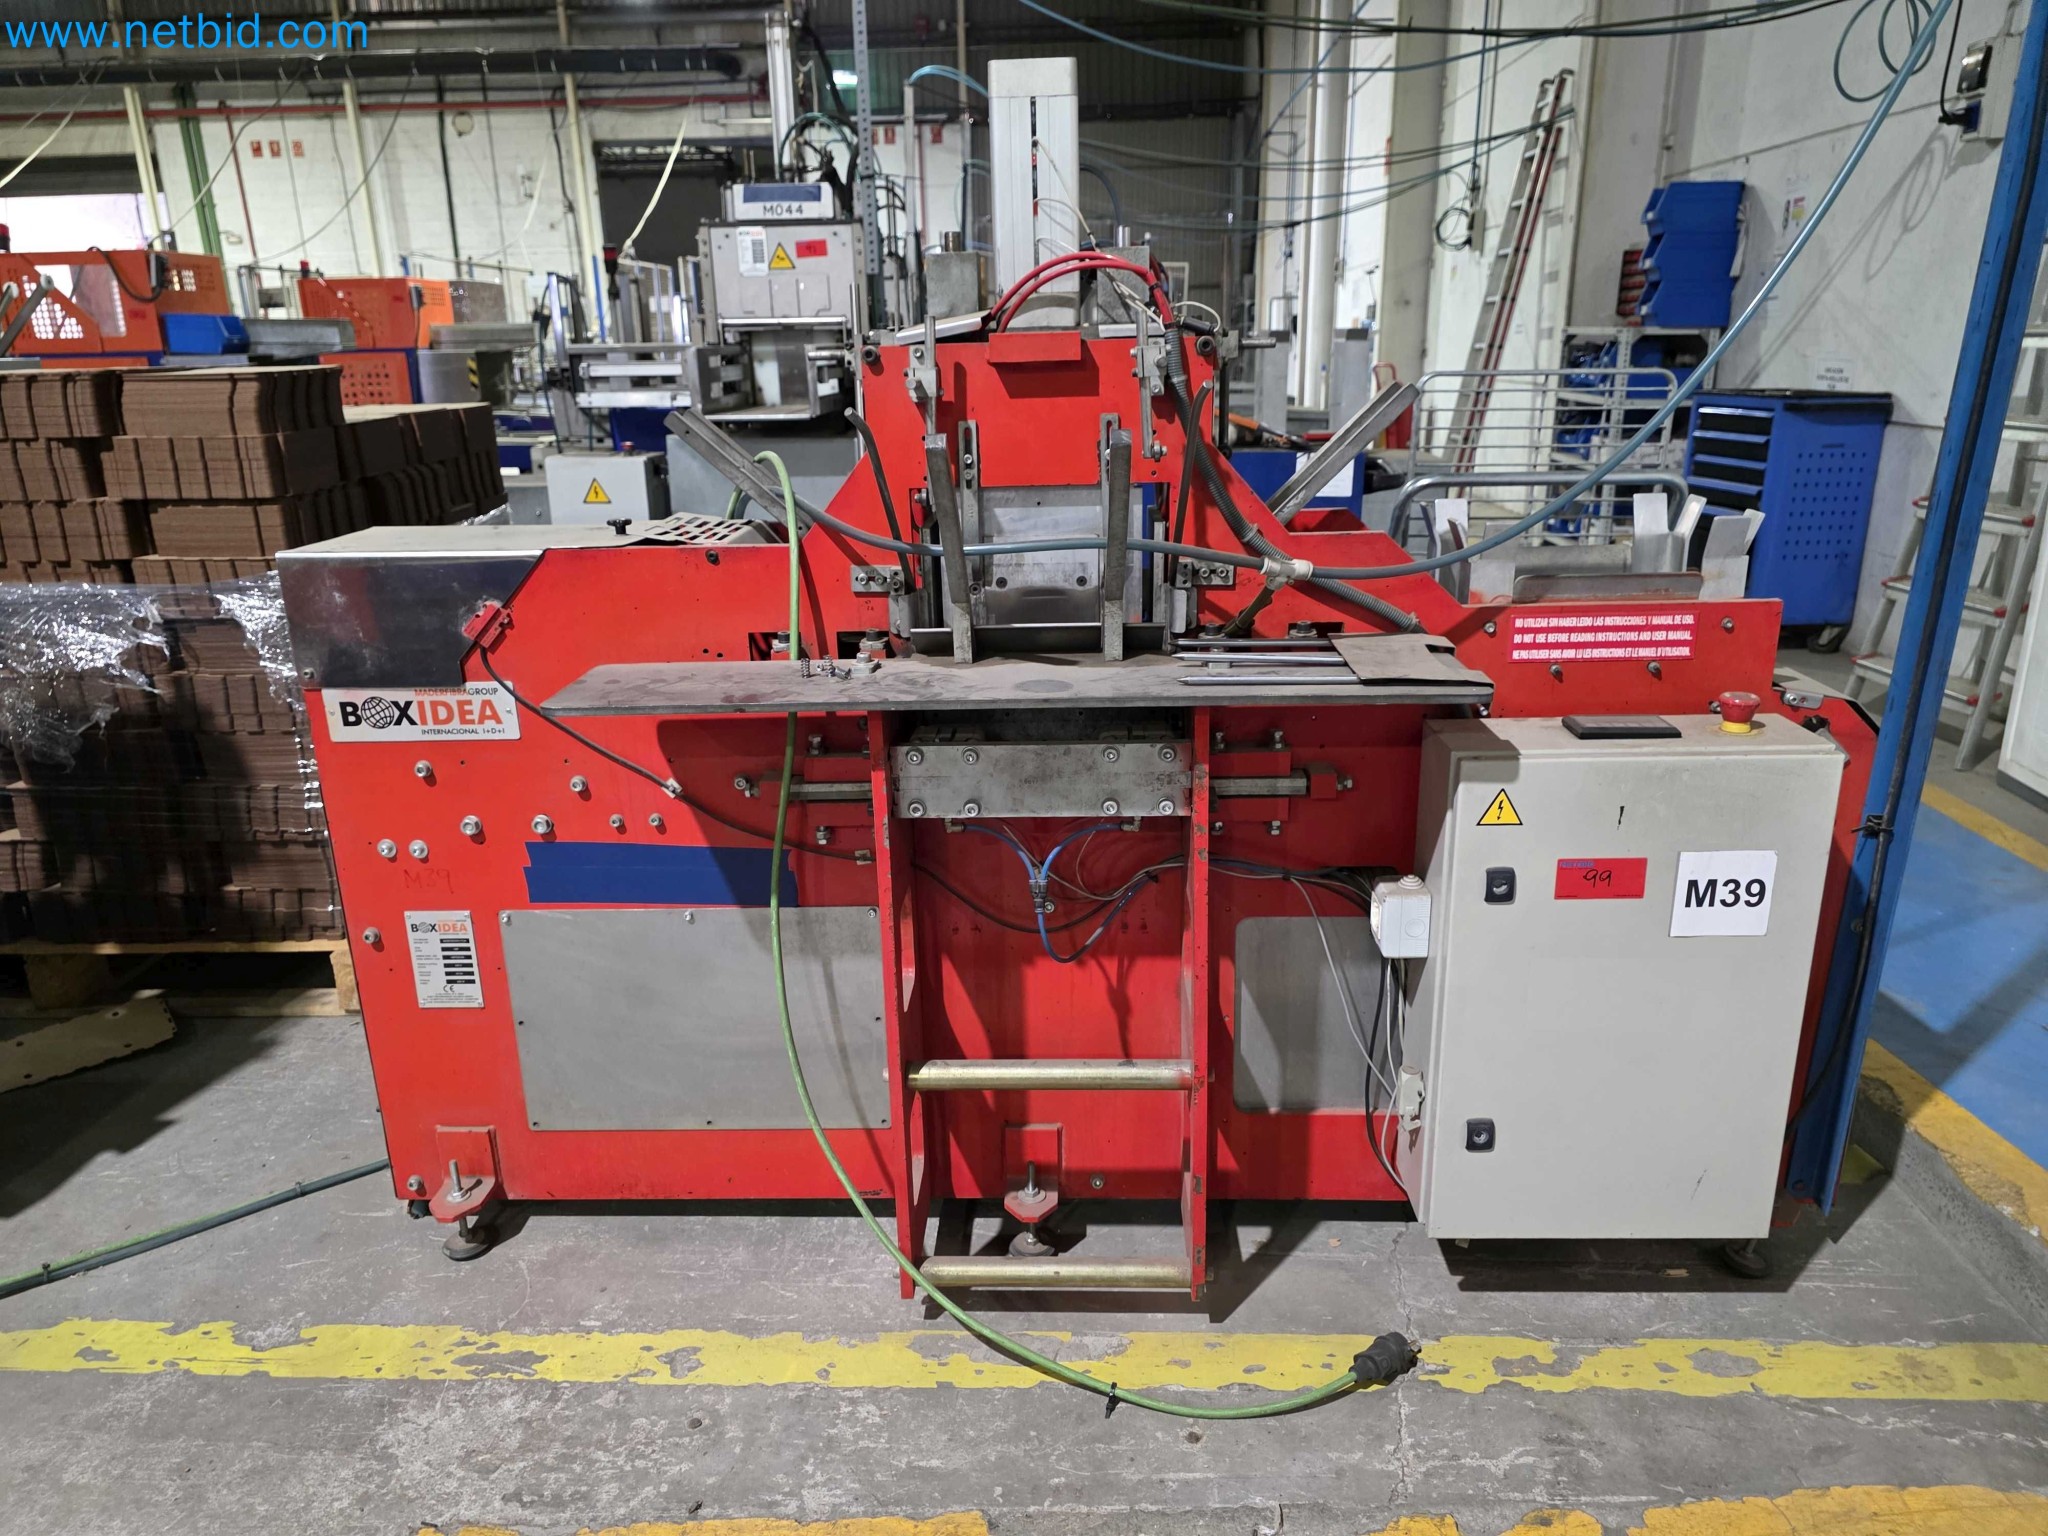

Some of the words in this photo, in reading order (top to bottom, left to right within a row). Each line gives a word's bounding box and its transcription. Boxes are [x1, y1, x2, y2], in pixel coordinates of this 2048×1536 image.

[1594, 616, 1604, 626] LAS
[1604, 615, 1647, 626] INSTRUCCIONES
[1652, 615, 1674, 625] MANUAL
[1674, 615, 1682, 624] DE
[1513, 634, 1522, 643] DO
[1523, 634, 1534, 643] NOT
[1536, 633, 1547, 643] USE
[1548, 633, 1570, 643] BEFORE
[1570, 632, 1596, 642] READING
[1596, 632, 1638, 642] INSTRUCTIONS
[1638, 631, 1652, 641] AND
[1652, 631, 1667, 641] USER
[339, 697, 504, 729] BOXIDEA
[421, 728, 480, 736] INTERNACIONAL
[1582, 869, 1613, 889] 99
[1684, 878, 1767, 908] M39
